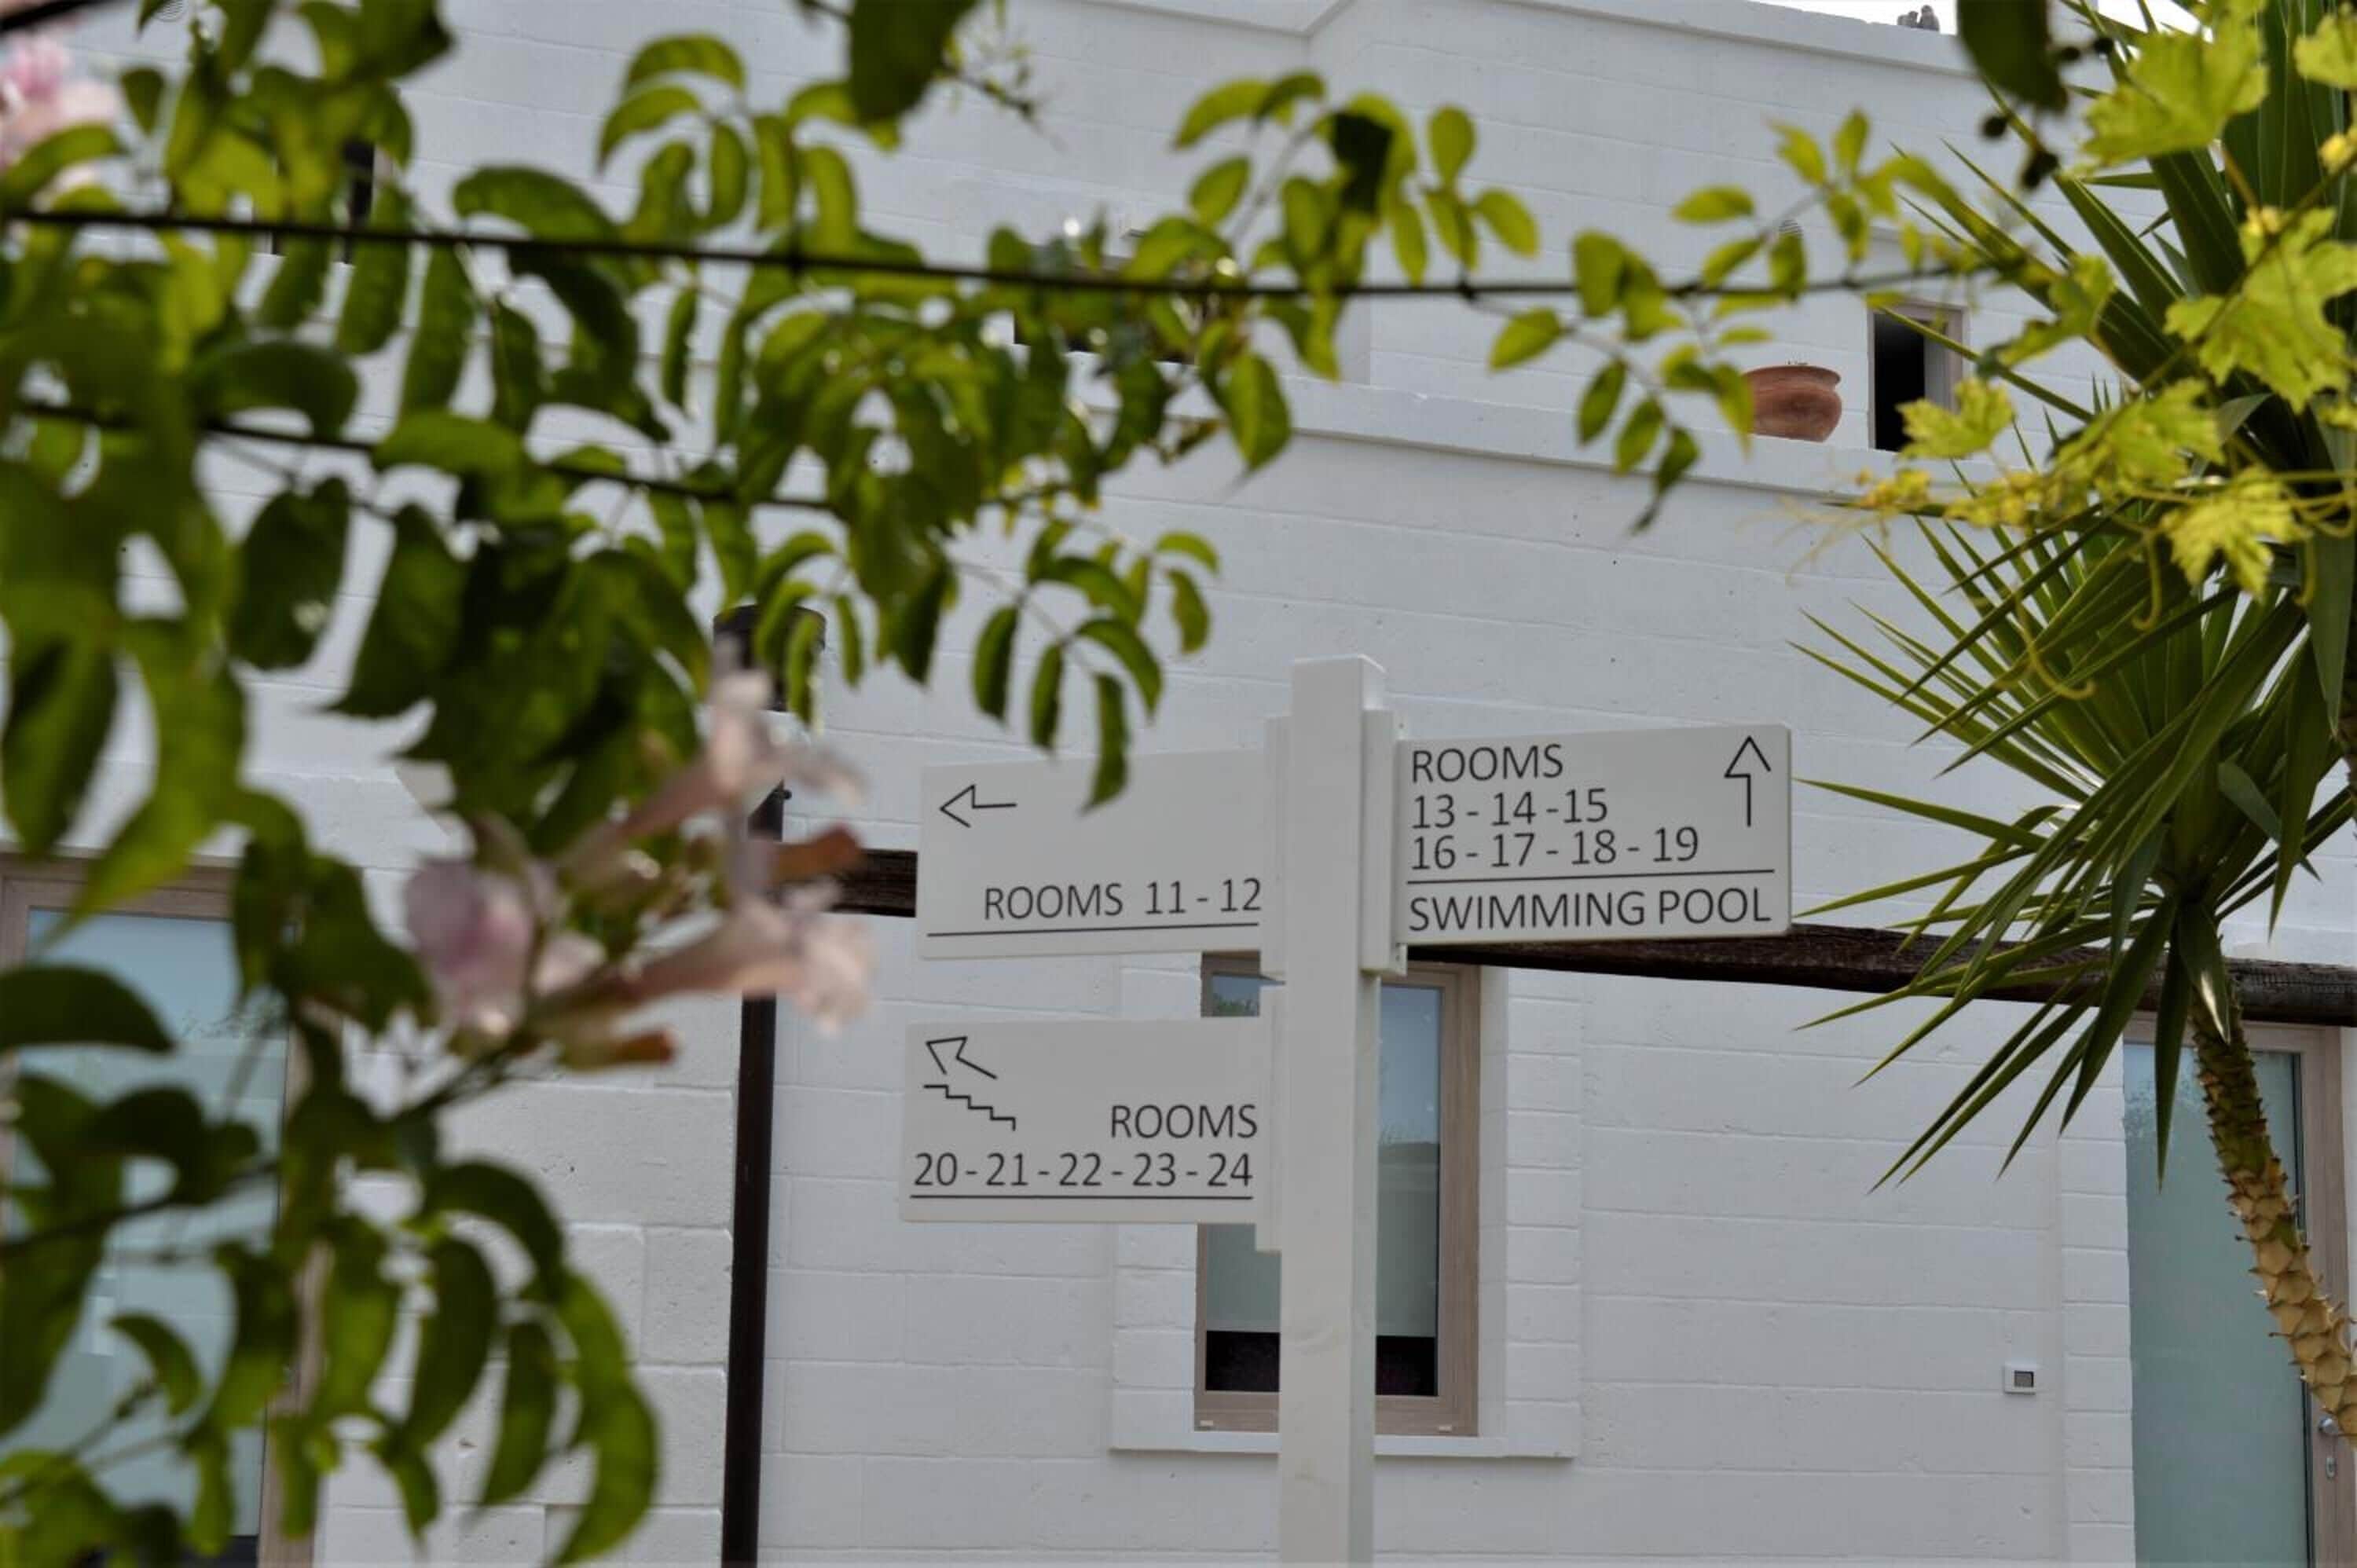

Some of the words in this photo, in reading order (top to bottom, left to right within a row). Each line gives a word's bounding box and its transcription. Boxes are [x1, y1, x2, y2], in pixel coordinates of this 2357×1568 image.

[1412, 742, 1564, 784] ROOMS
[984, 882, 1124, 921] ROOMS
[1409, 890, 1646, 932] SWIMMING
[1659, 887, 1772, 925] POOL
[1110, 1104, 1258, 1139] ROOMS
